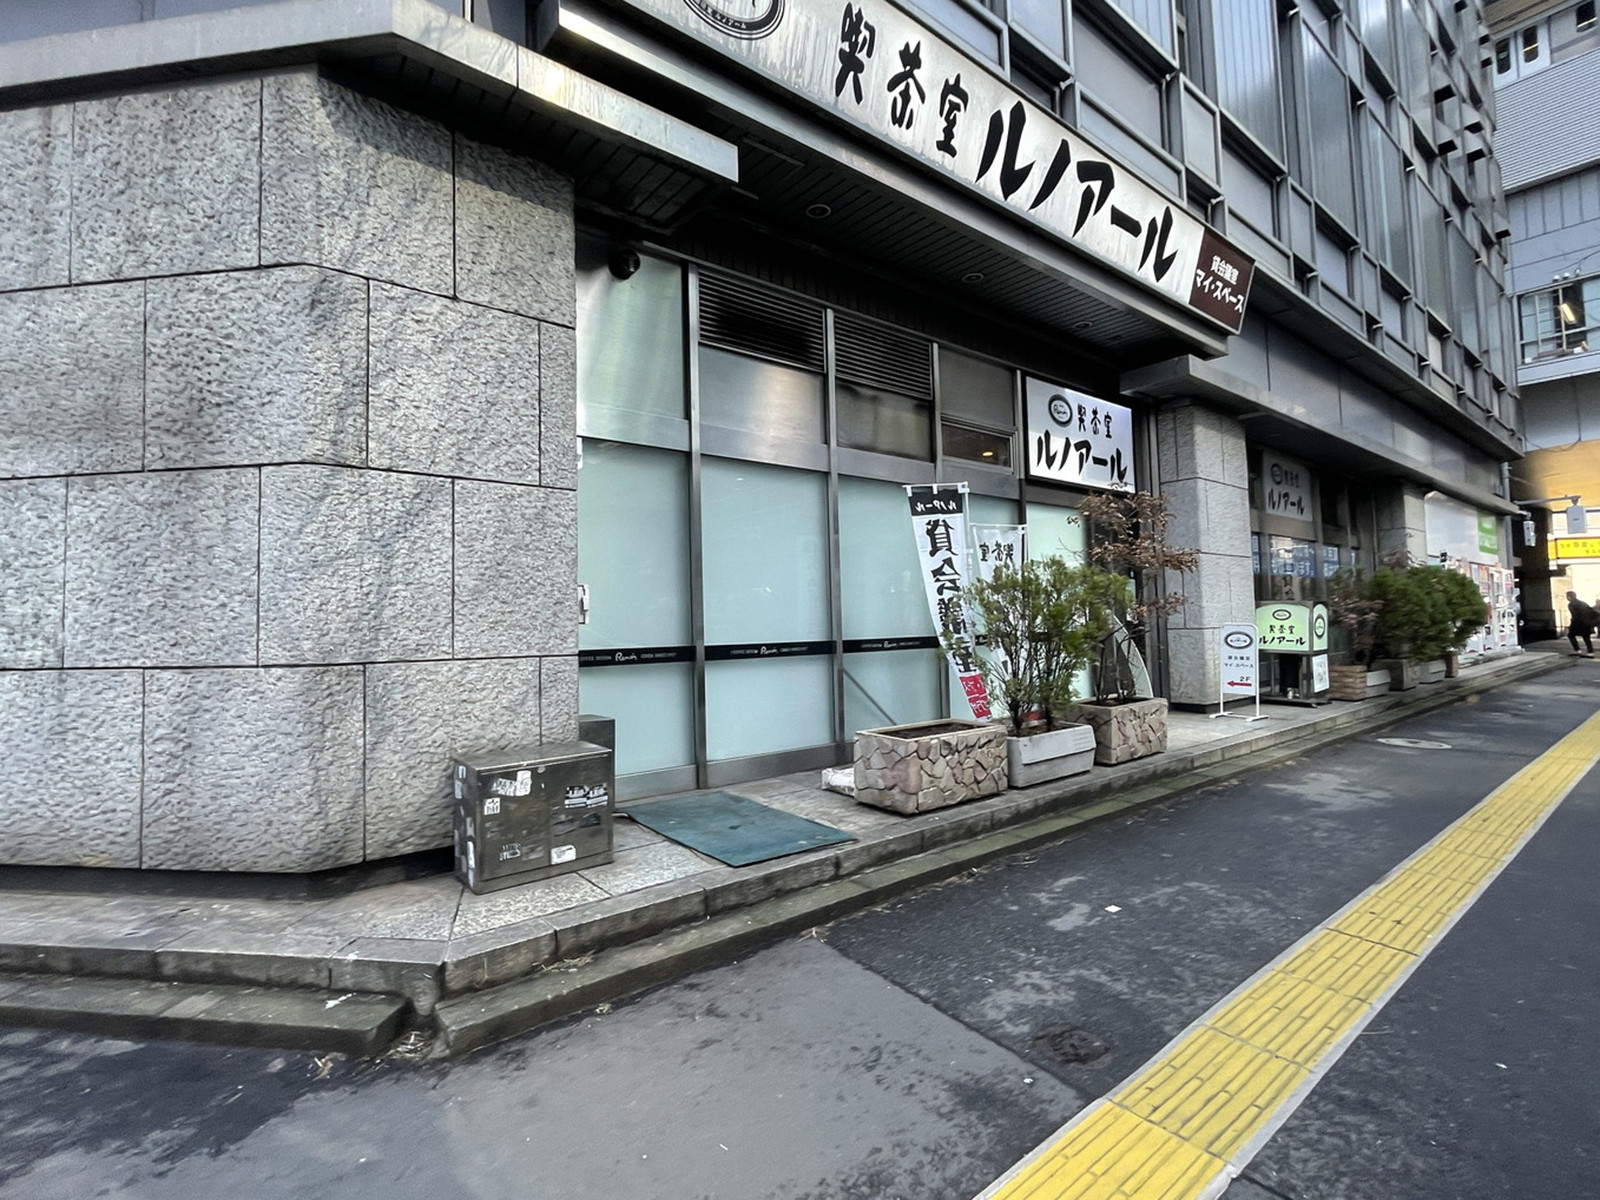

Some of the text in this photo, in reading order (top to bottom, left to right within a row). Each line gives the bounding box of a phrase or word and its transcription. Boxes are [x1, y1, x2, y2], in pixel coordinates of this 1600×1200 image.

[1211, 255, 1239, 285] 貸会議室
[1196, 268, 1245, 313] マイ・スペース
[1077, 403, 1113, 439] 喫茶室
[1036, 429, 1128, 484] ルノアール
[1268, 488, 1305, 516] ルノアール
[1258, 635, 1306, 646] ルノアール
